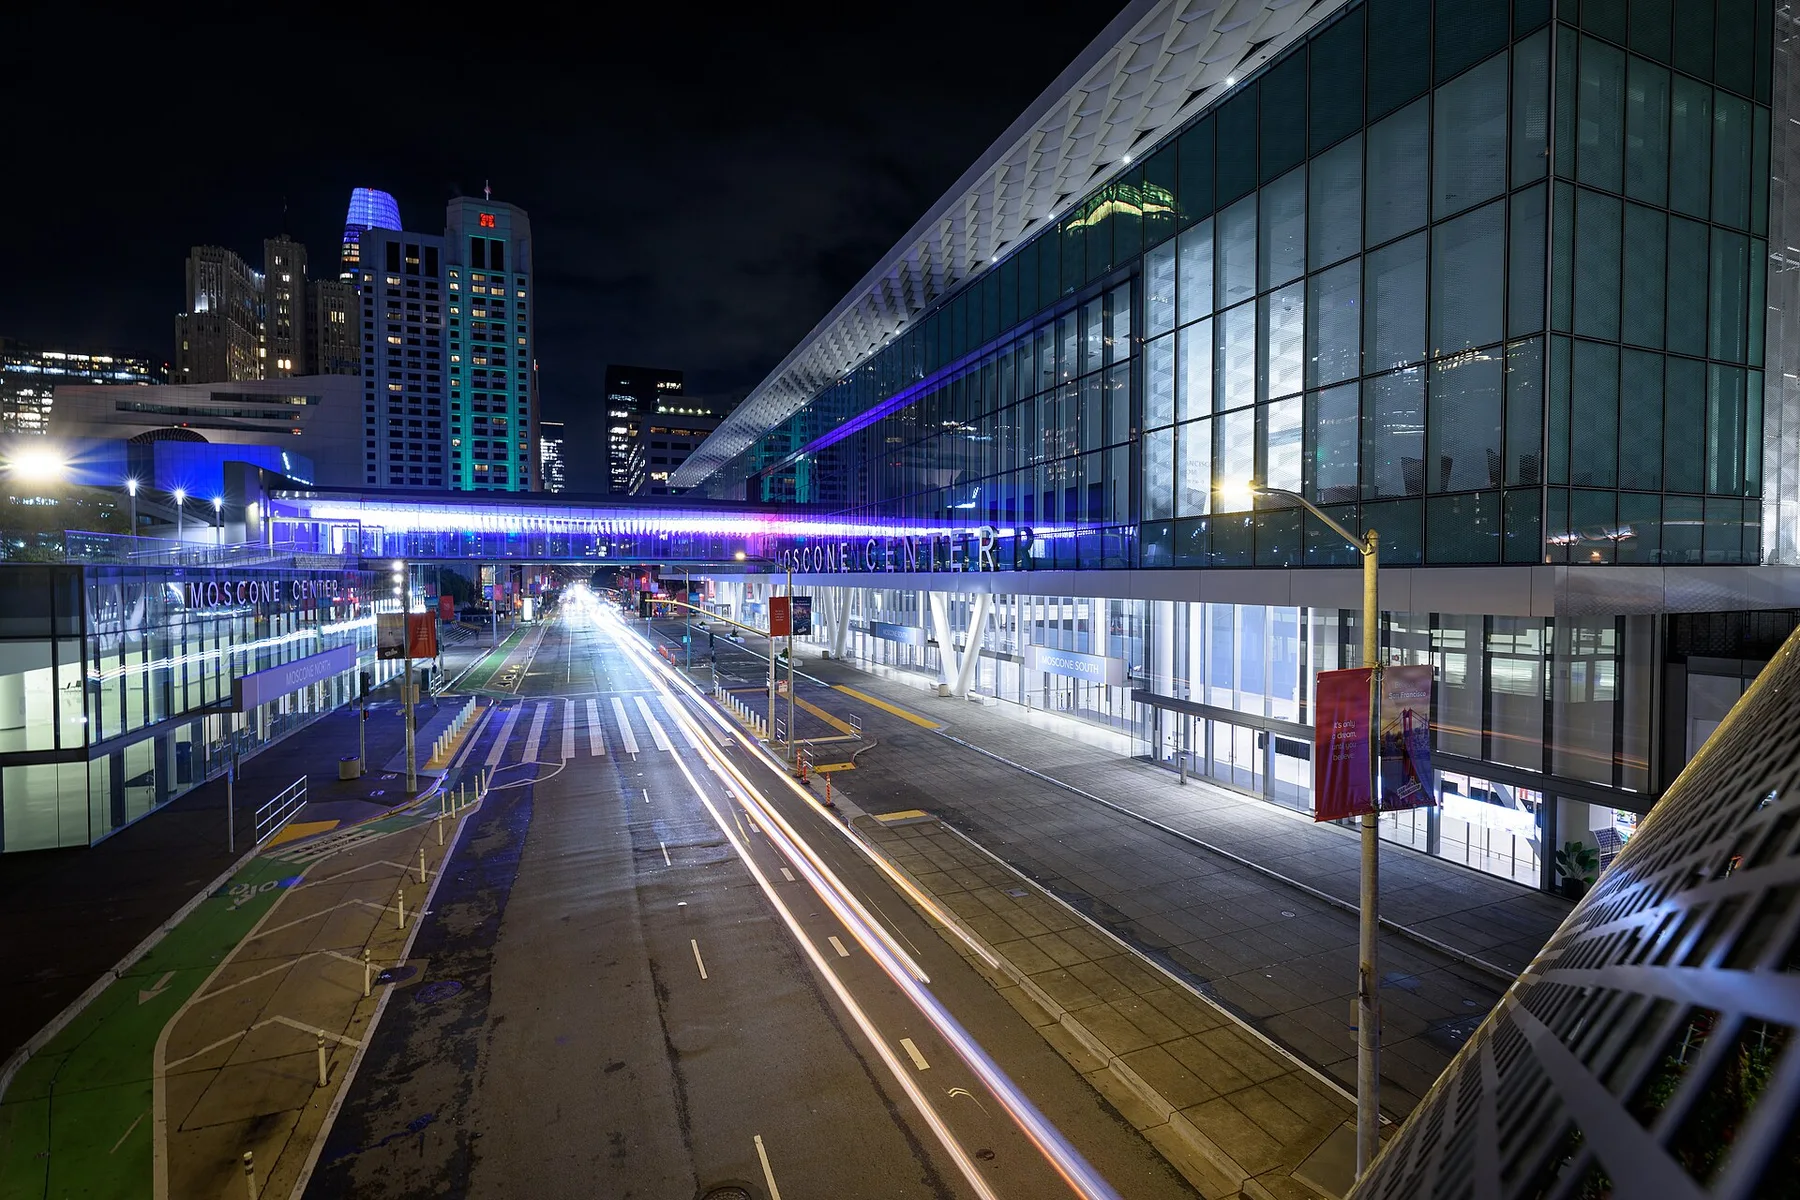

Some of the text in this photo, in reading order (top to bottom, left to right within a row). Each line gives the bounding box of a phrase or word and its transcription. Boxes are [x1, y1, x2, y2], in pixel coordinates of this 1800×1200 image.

[865, 525, 995, 573] CENTER
[190, 579, 338, 608] MOSCONE CENTER
[286, 659, 331, 685] MOSCONE NORTH
[1042, 655, 1099, 674] MOSCONE SOUTH
